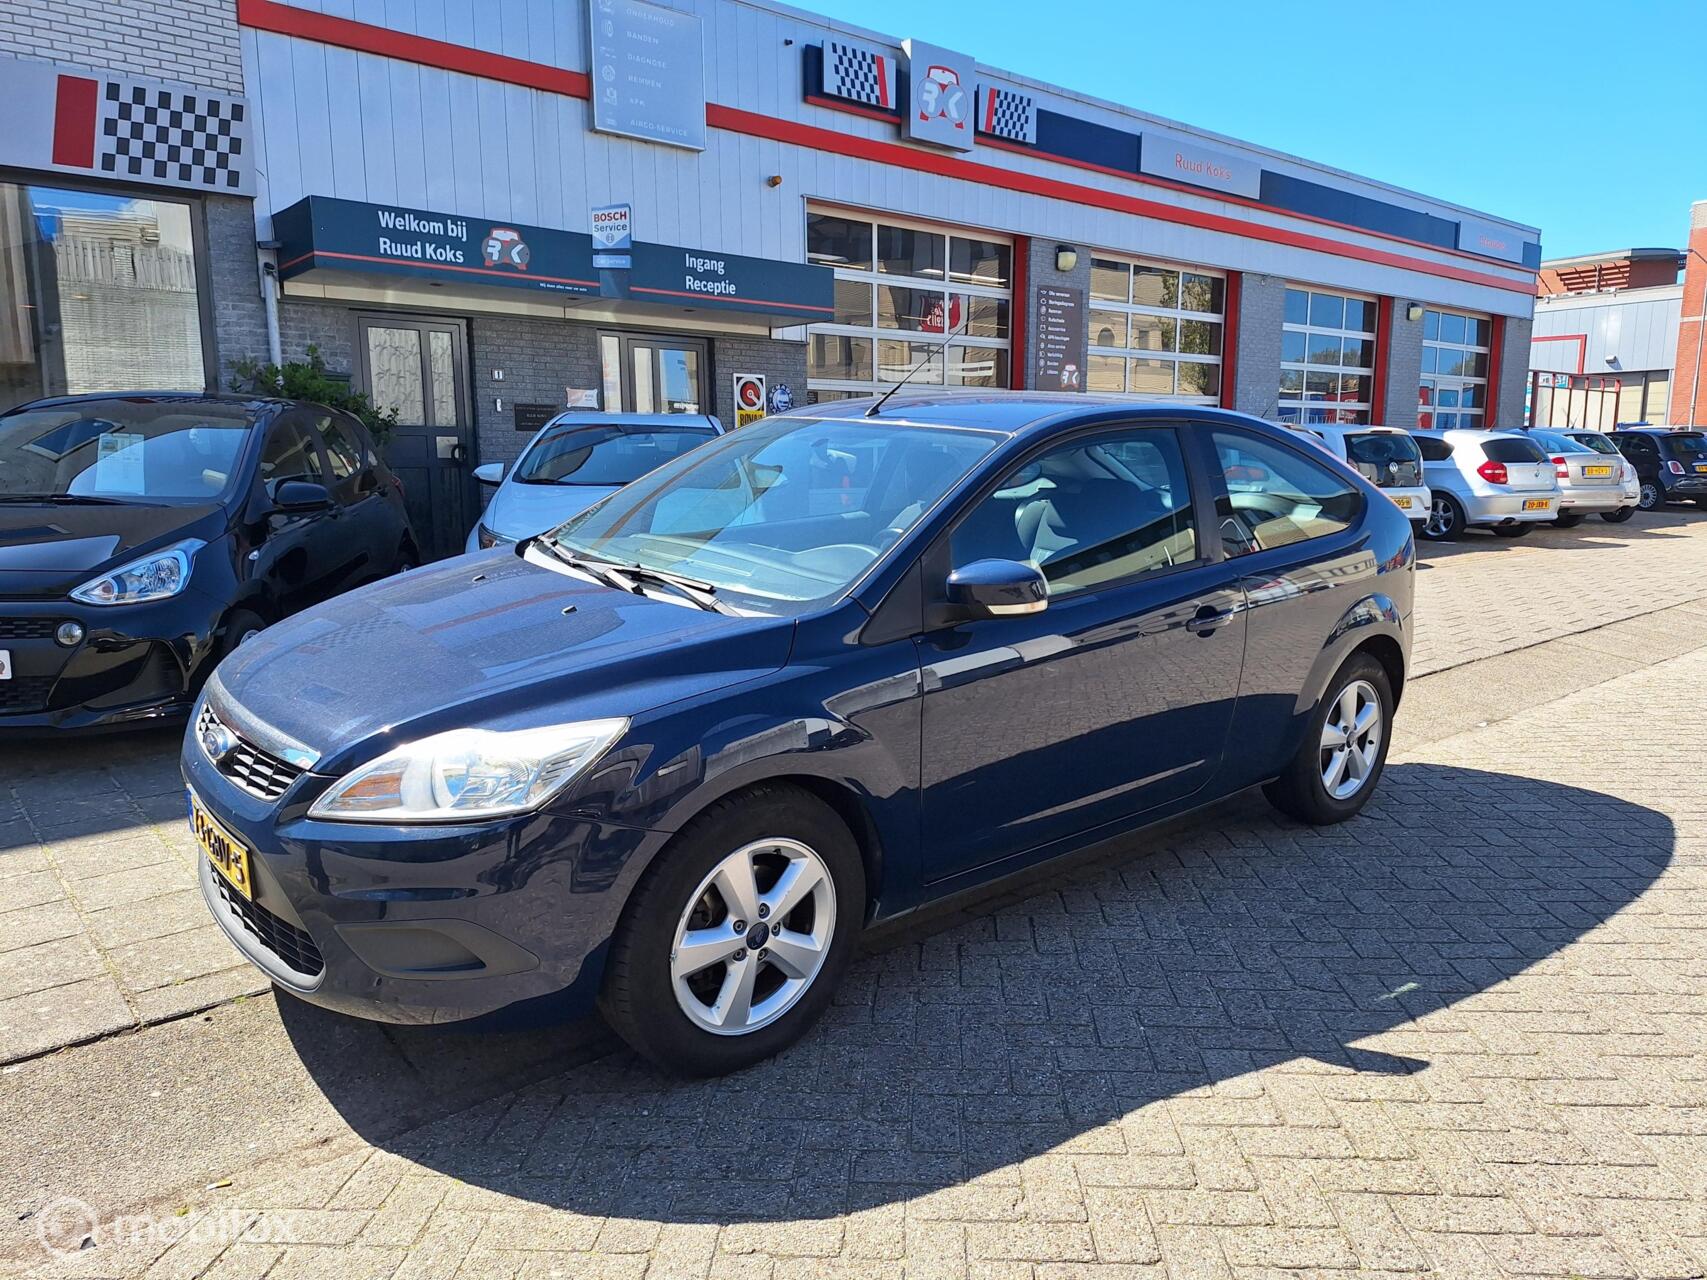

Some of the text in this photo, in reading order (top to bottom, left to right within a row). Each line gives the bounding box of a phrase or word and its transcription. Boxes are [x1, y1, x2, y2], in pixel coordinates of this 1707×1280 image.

[626, 31, 659, 45] BANDEN
[627, 53, 667, 69] DIAGNOSE
[1175, 153, 1232, 180] Ruud Koks
[378, 210, 467, 242] Welkom bij
[593, 210, 628, 223] BOSCH
[594, 223, 628, 233] Service
[379, 237, 464, 263] Ruud Koks
[685, 253, 725, 275] Ingang
[685, 275, 736, 296] Receptie
